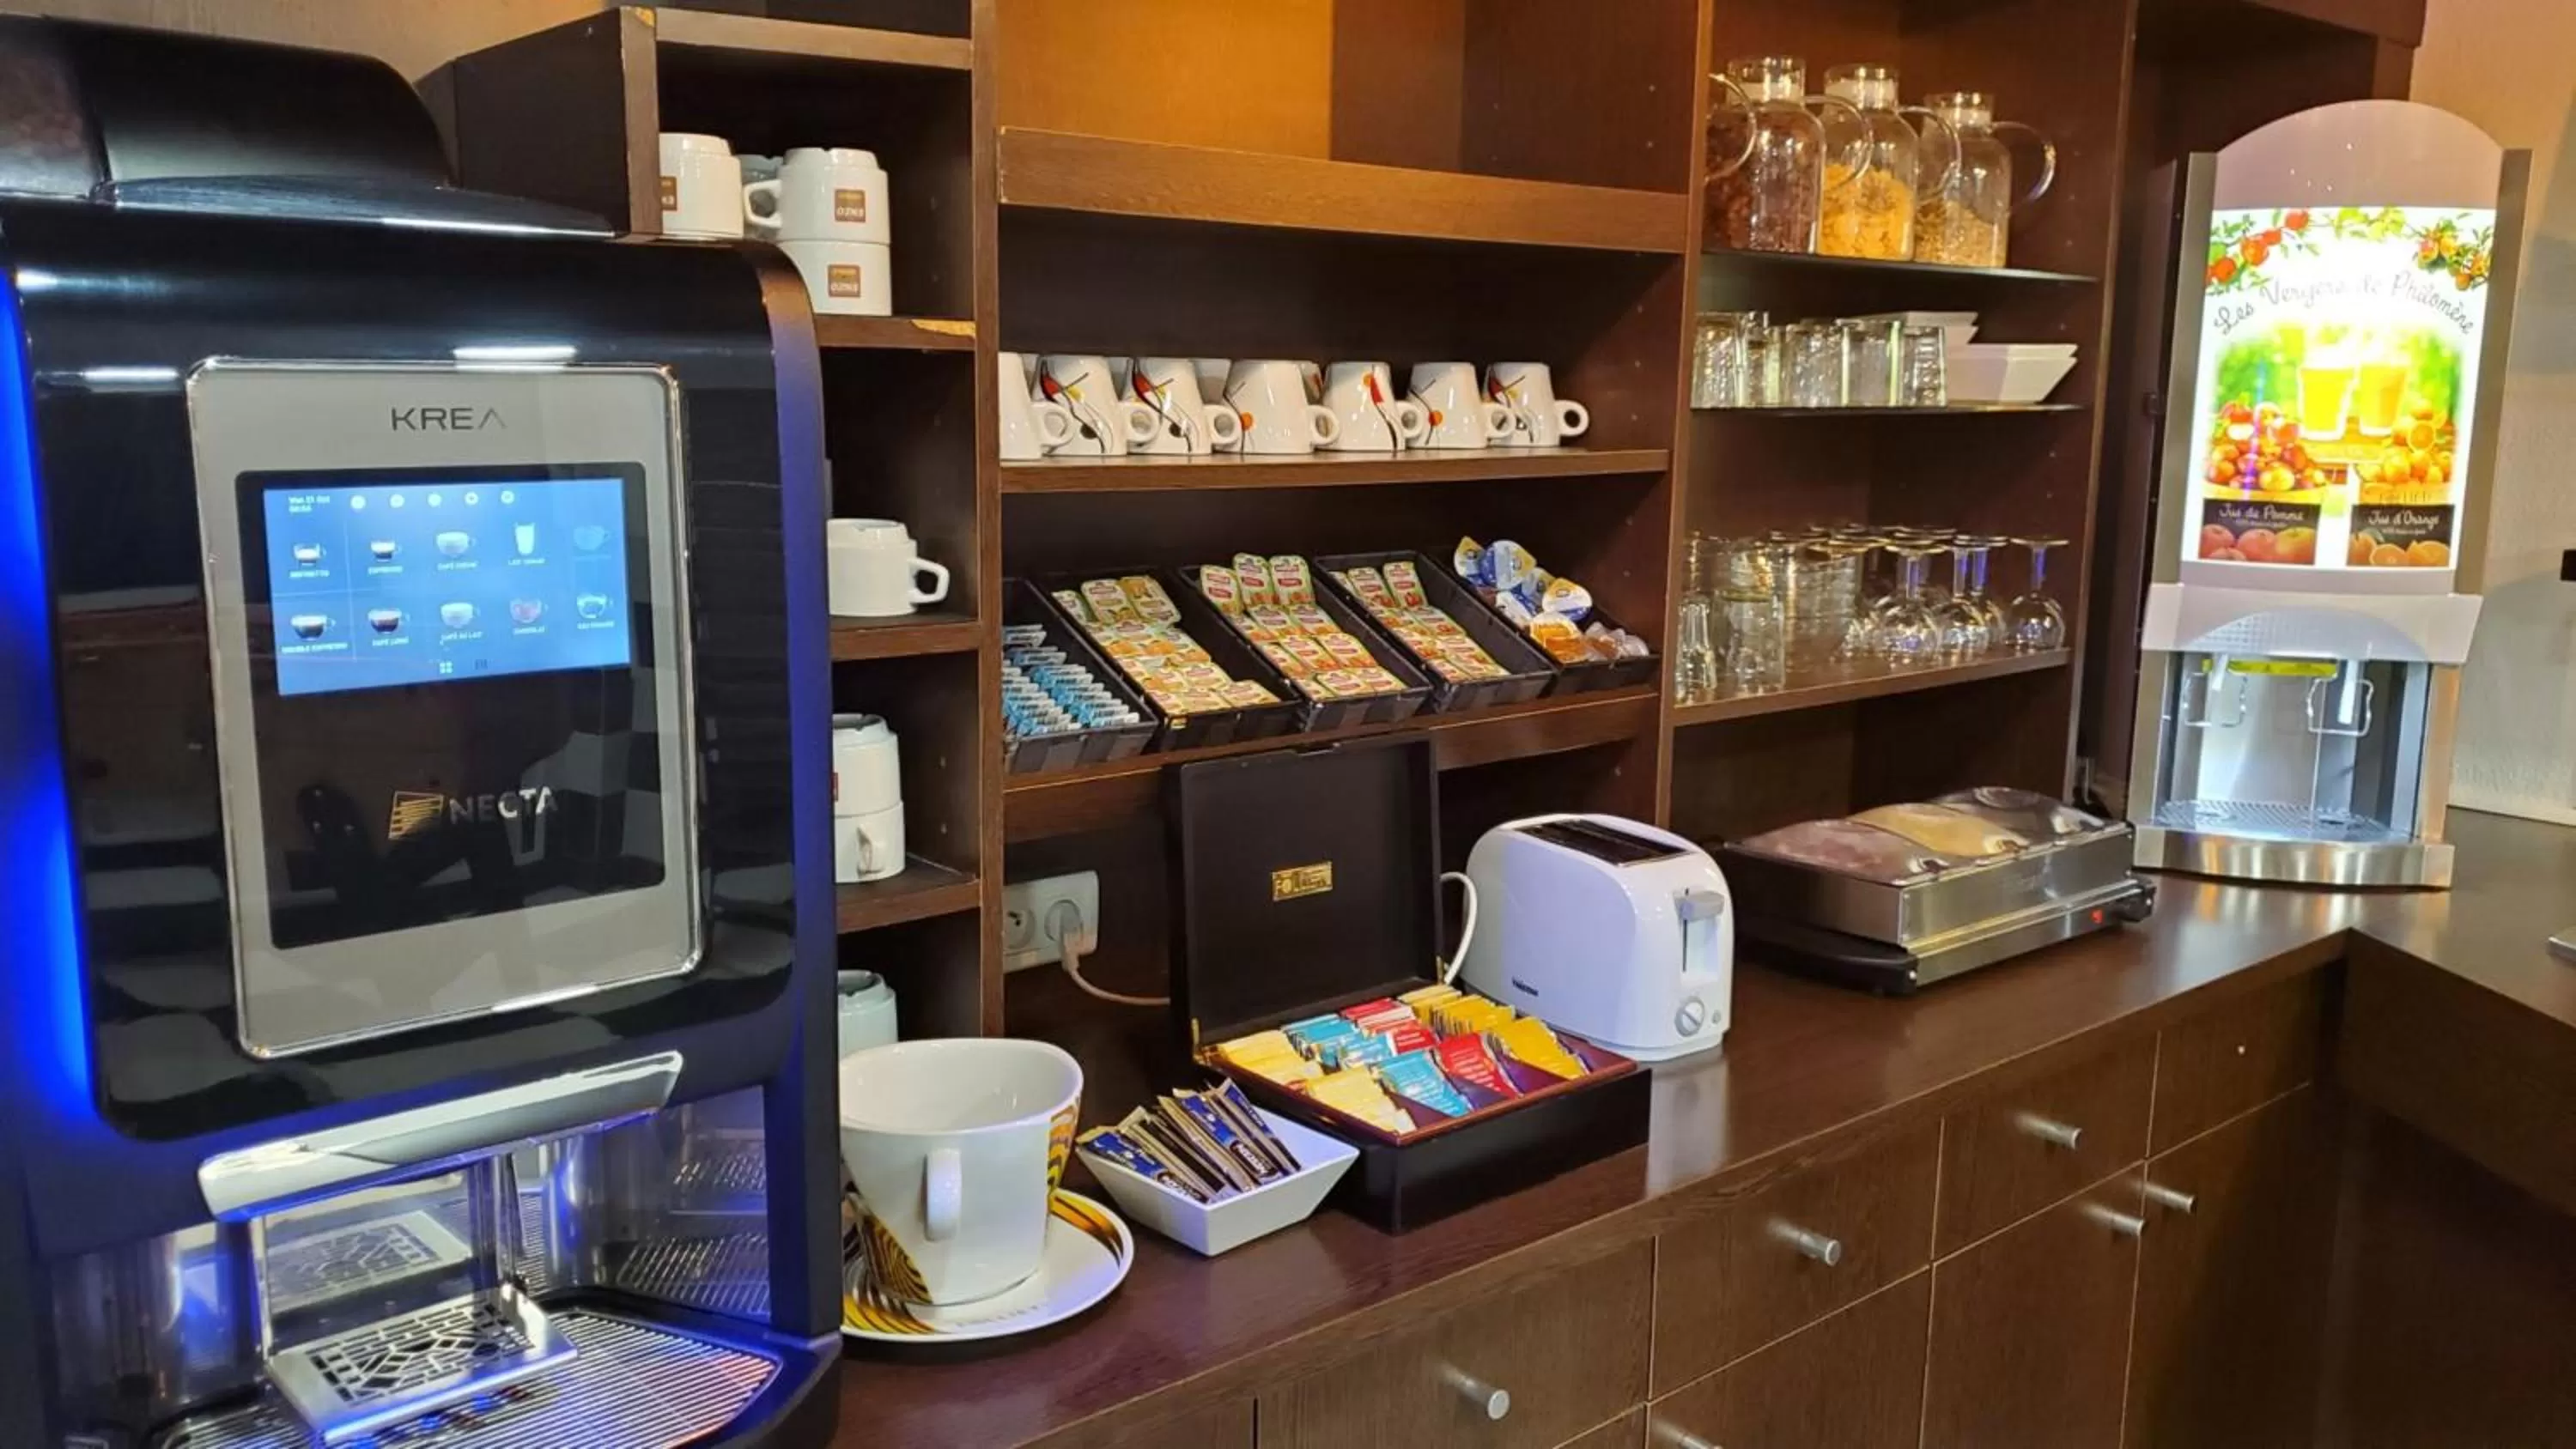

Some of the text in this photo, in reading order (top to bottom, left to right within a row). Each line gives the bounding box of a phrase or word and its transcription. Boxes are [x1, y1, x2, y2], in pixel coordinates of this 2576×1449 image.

[2214, 302, 2254, 336] Les
[2218, 503, 2241, 518] Jus
[2367, 510, 2390, 526] Jus
[449, 786, 558, 825] NECTA
